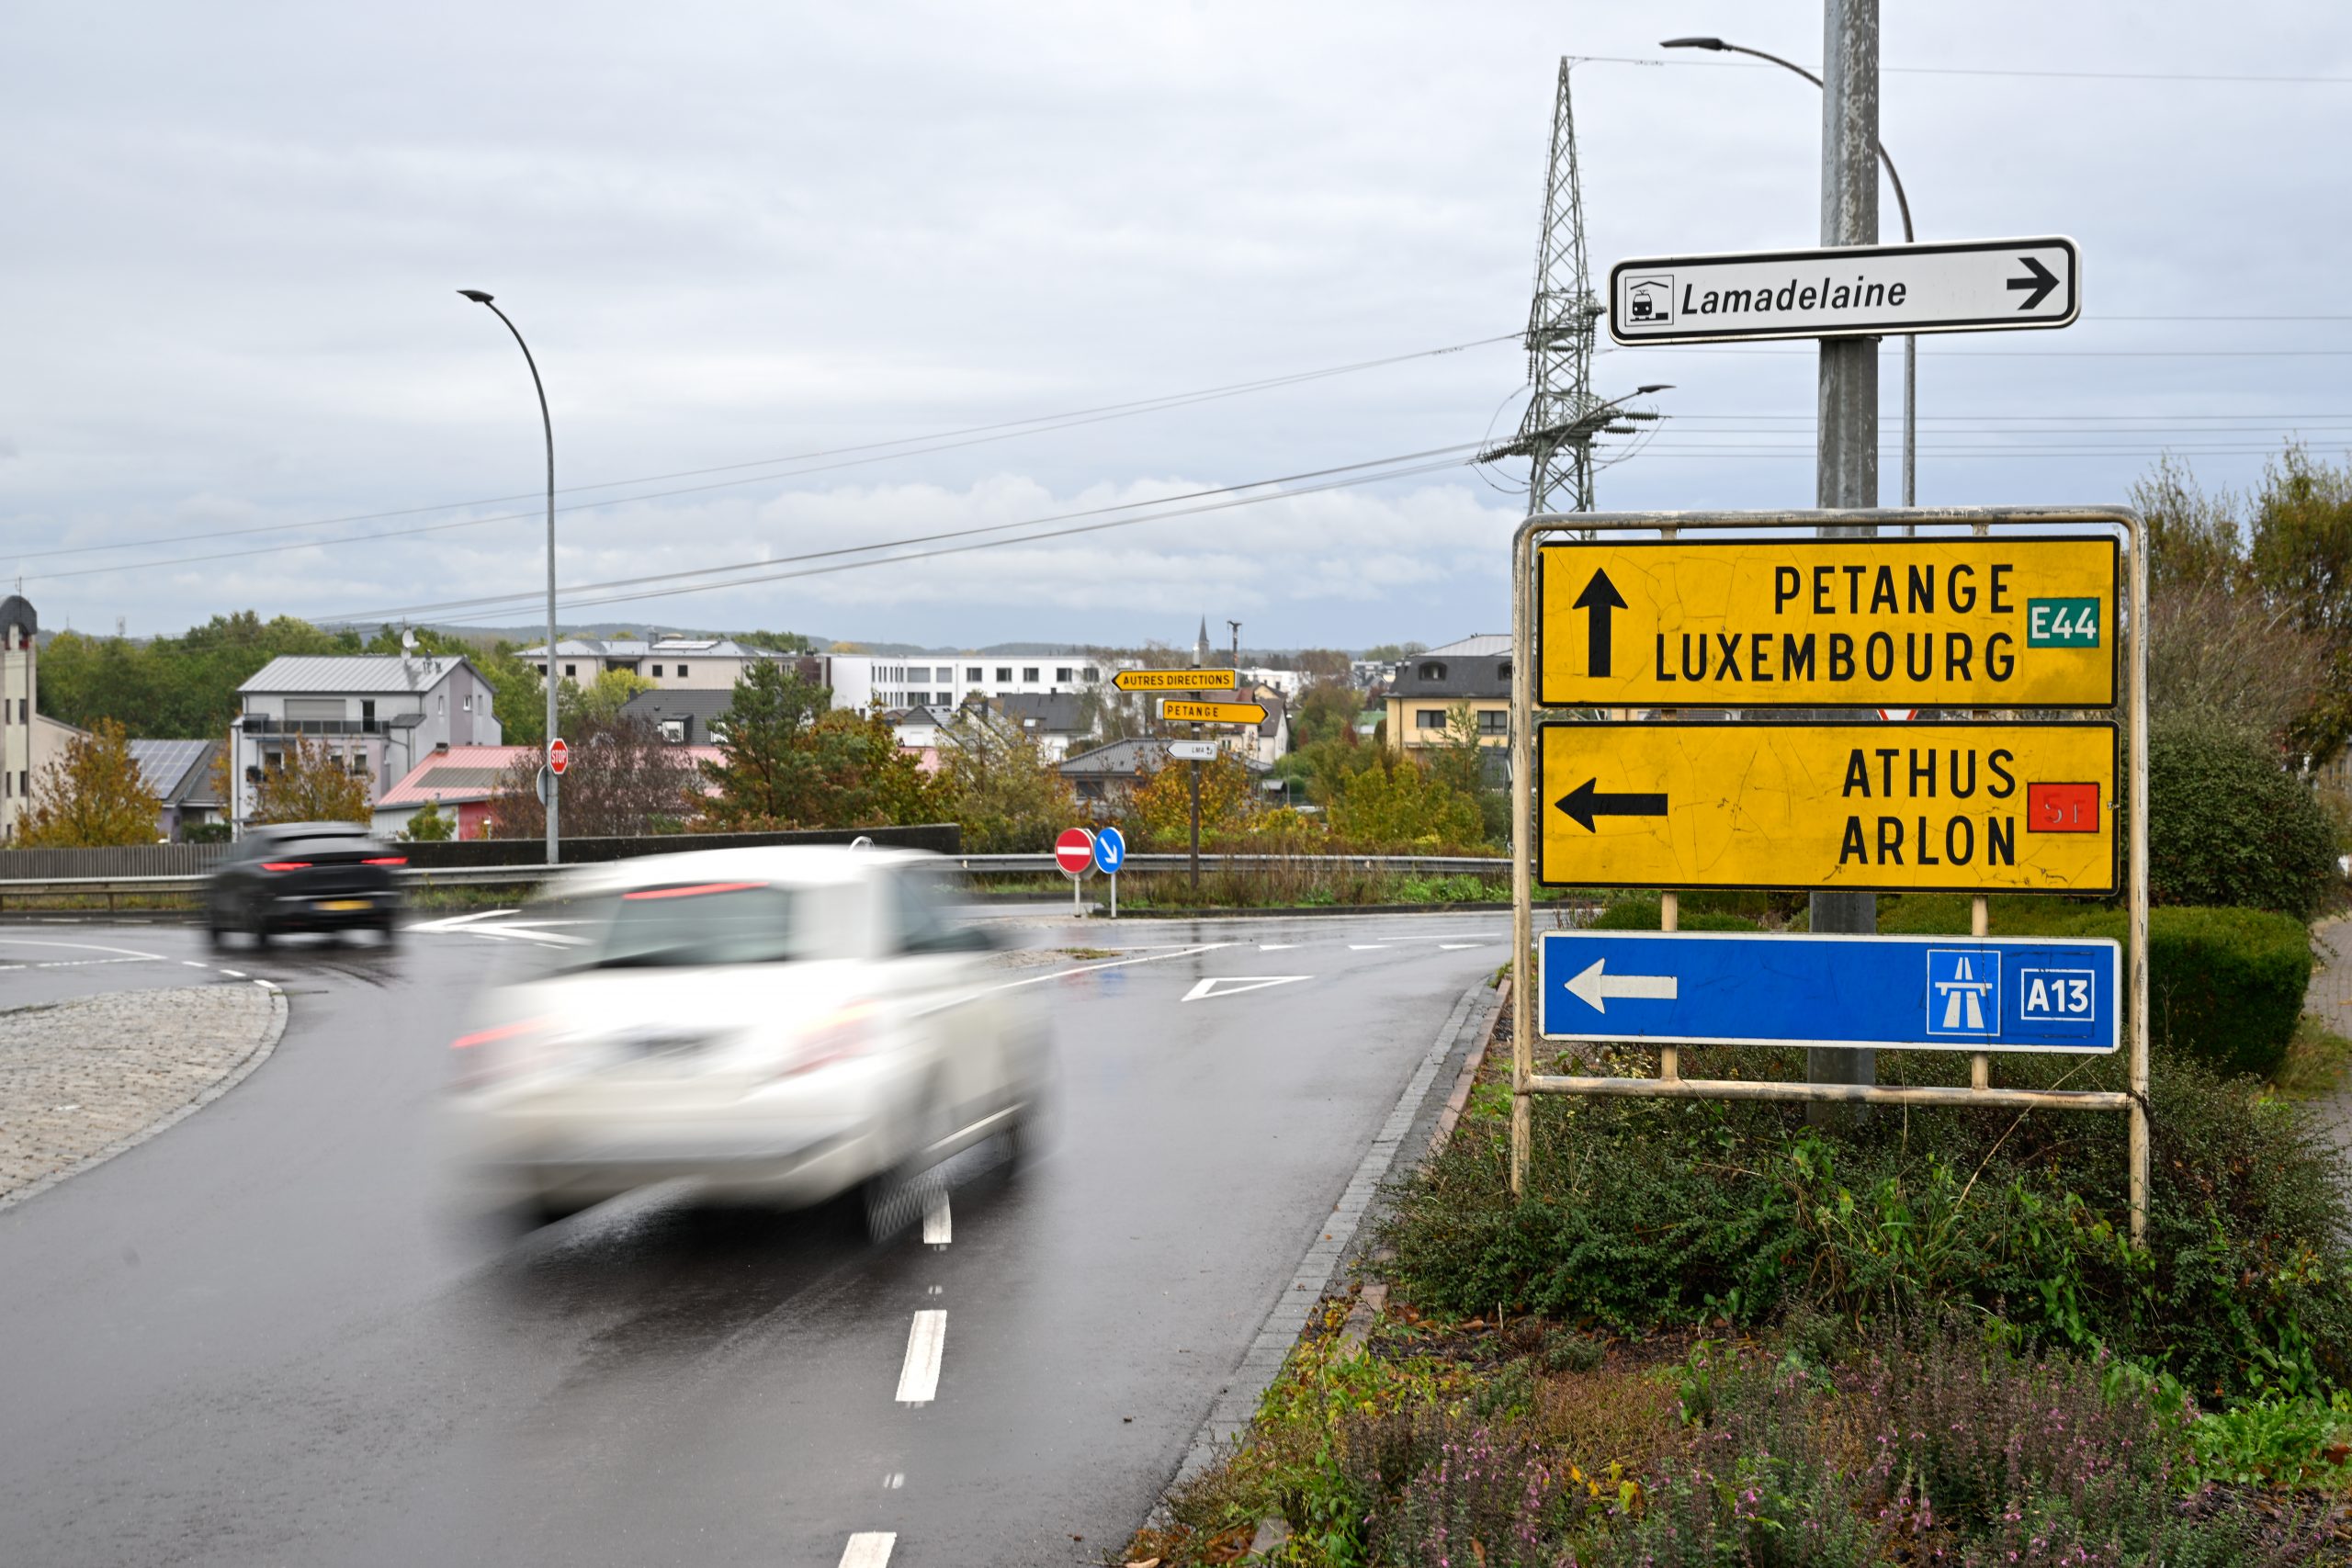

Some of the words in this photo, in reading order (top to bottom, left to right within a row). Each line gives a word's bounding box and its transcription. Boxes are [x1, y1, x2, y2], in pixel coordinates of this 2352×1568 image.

[1681, 276, 1907, 315] Lamadelaine
[1774, 563, 2014, 615] PETANGE
[2031, 606, 2097, 639] E44
[1656, 631, 2015, 682] LUXEMBOURG
[1123, 675, 1164, 686] AUTRES
[1167, 674, 1230, 685] DIRECTIONS
[1167, 705, 1219, 718] PETANGE
[551, 750, 567, 763] STOP
[1841, 748, 2016, 799] ATHUS
[1838, 815, 2015, 866] ARLON
[2027, 978, 2088, 1012] A13
